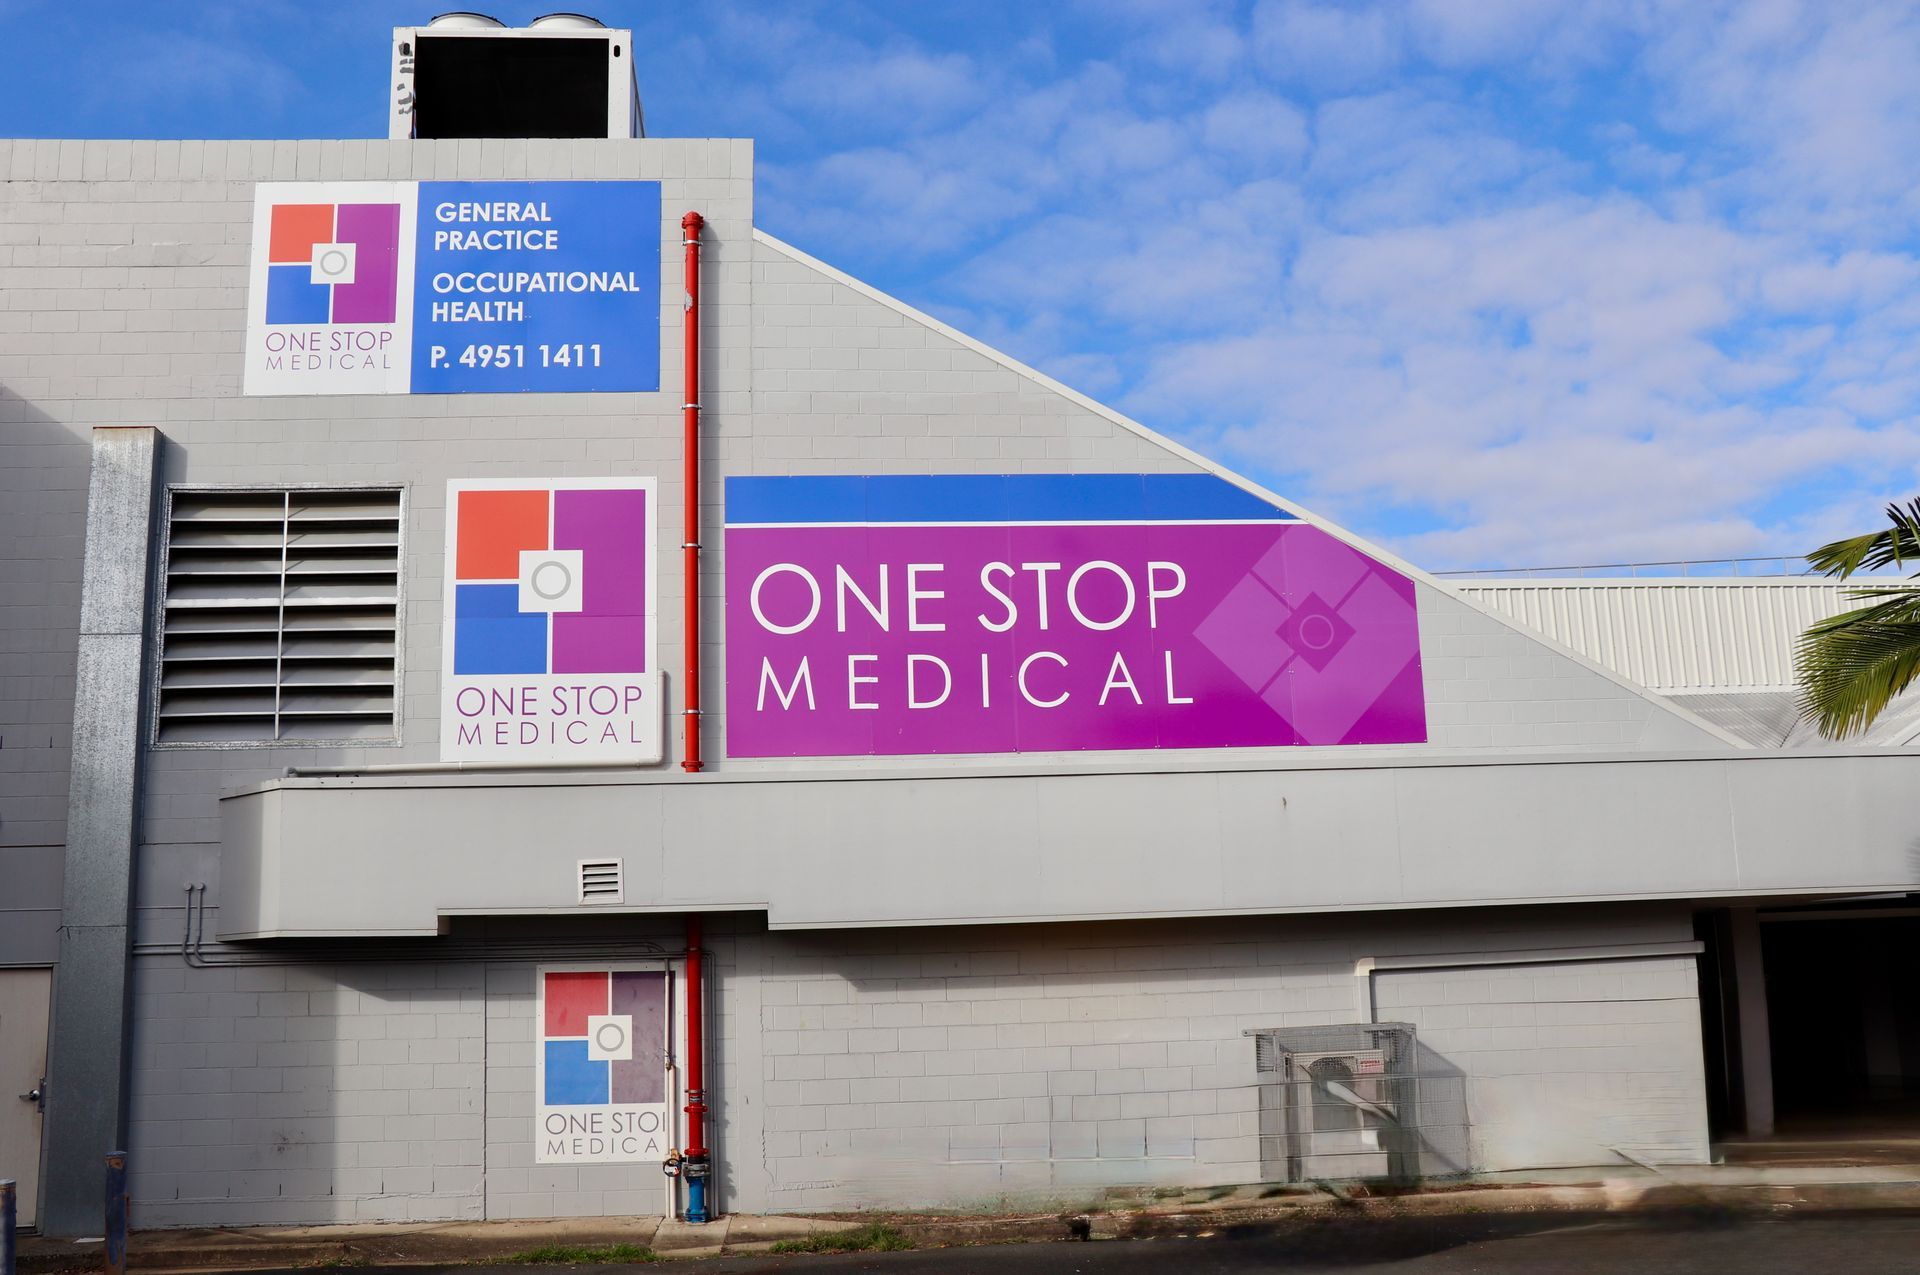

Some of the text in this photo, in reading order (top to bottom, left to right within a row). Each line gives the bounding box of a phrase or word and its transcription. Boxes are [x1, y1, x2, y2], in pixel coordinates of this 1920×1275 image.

[436, 203, 551, 222] GENERAL
[435, 230, 557, 250] PRACTICE
[433, 272, 639, 293] OCCUPATIONAL
[432, 302, 523, 321] HEALTH
[266, 331, 392, 352] ONE STOP
[266, 354, 391, 370] MEDICAL
[431, 344, 600, 368] P. 4951 1411
[751, 561, 1186, 634] ONE STOP
[757, 651, 1193, 711] MEDICAL
[457, 686, 642, 717] ONE STOP
[458, 721, 641, 745] MEDICAL
[546, 1112, 665, 1135] ONE STO
[547, 1137, 659, 1155] MEDICA
